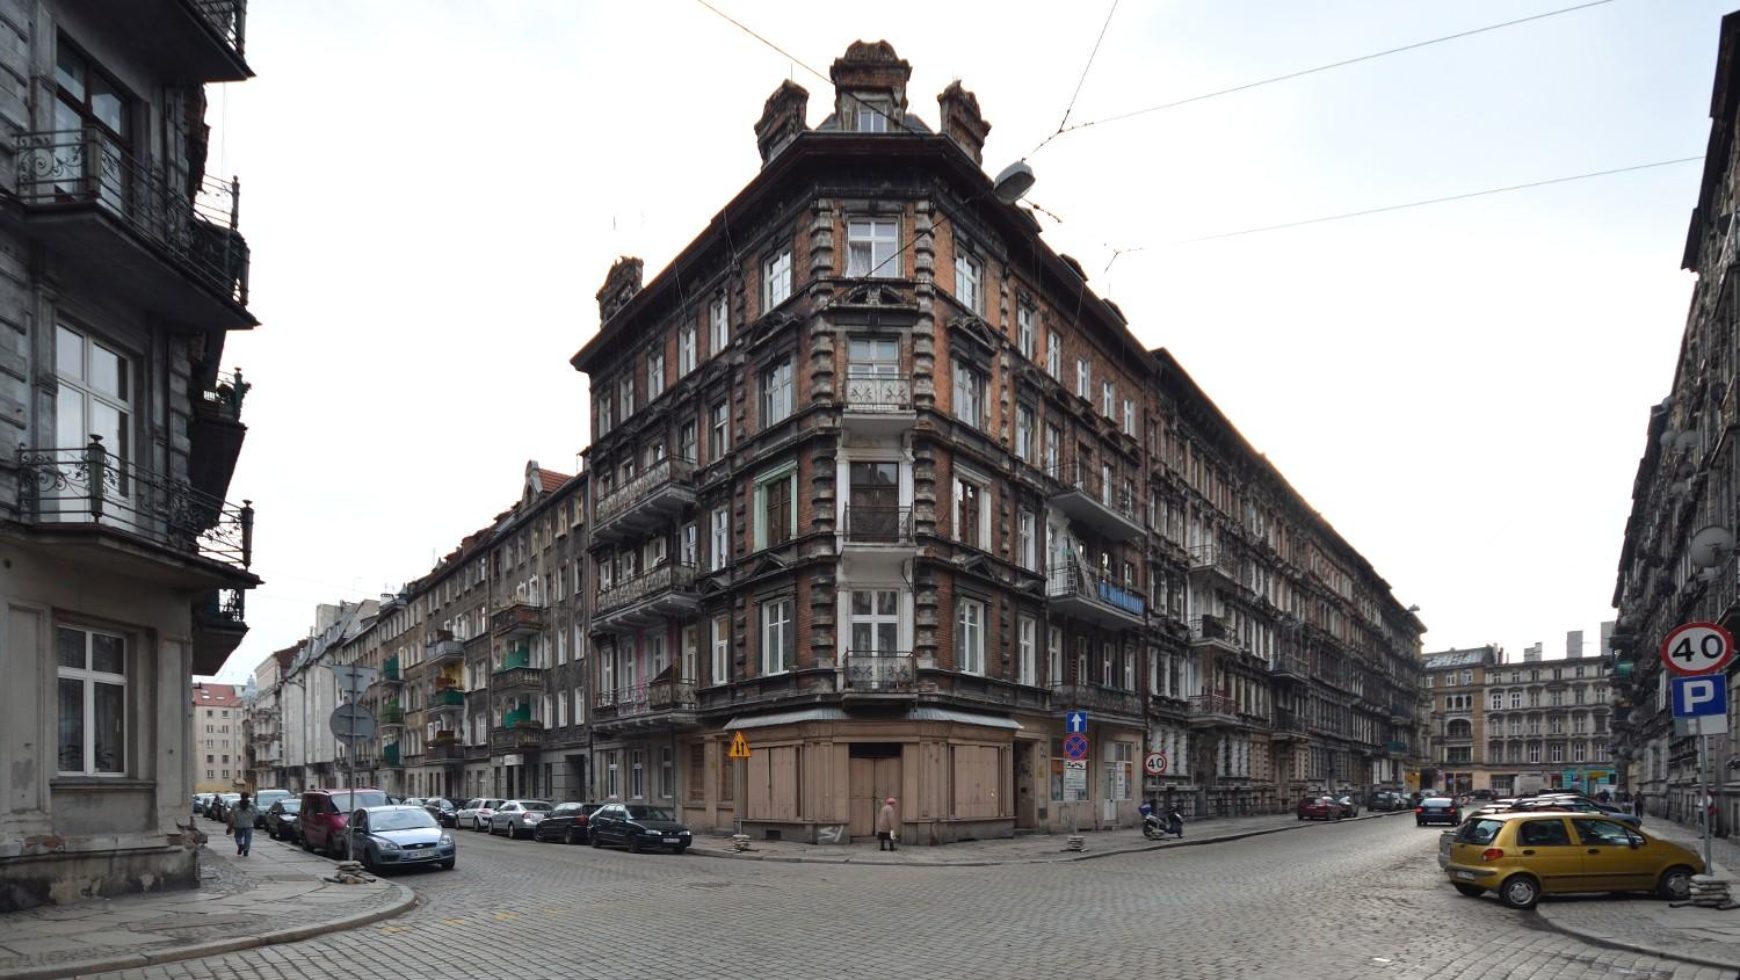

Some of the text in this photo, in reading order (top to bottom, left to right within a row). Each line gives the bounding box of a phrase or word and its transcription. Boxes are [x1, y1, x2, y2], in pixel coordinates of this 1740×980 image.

[1672, 634, 1723, 662] 40
[1683, 680, 1714, 712] P
[1147, 757, 1164, 769] 40
